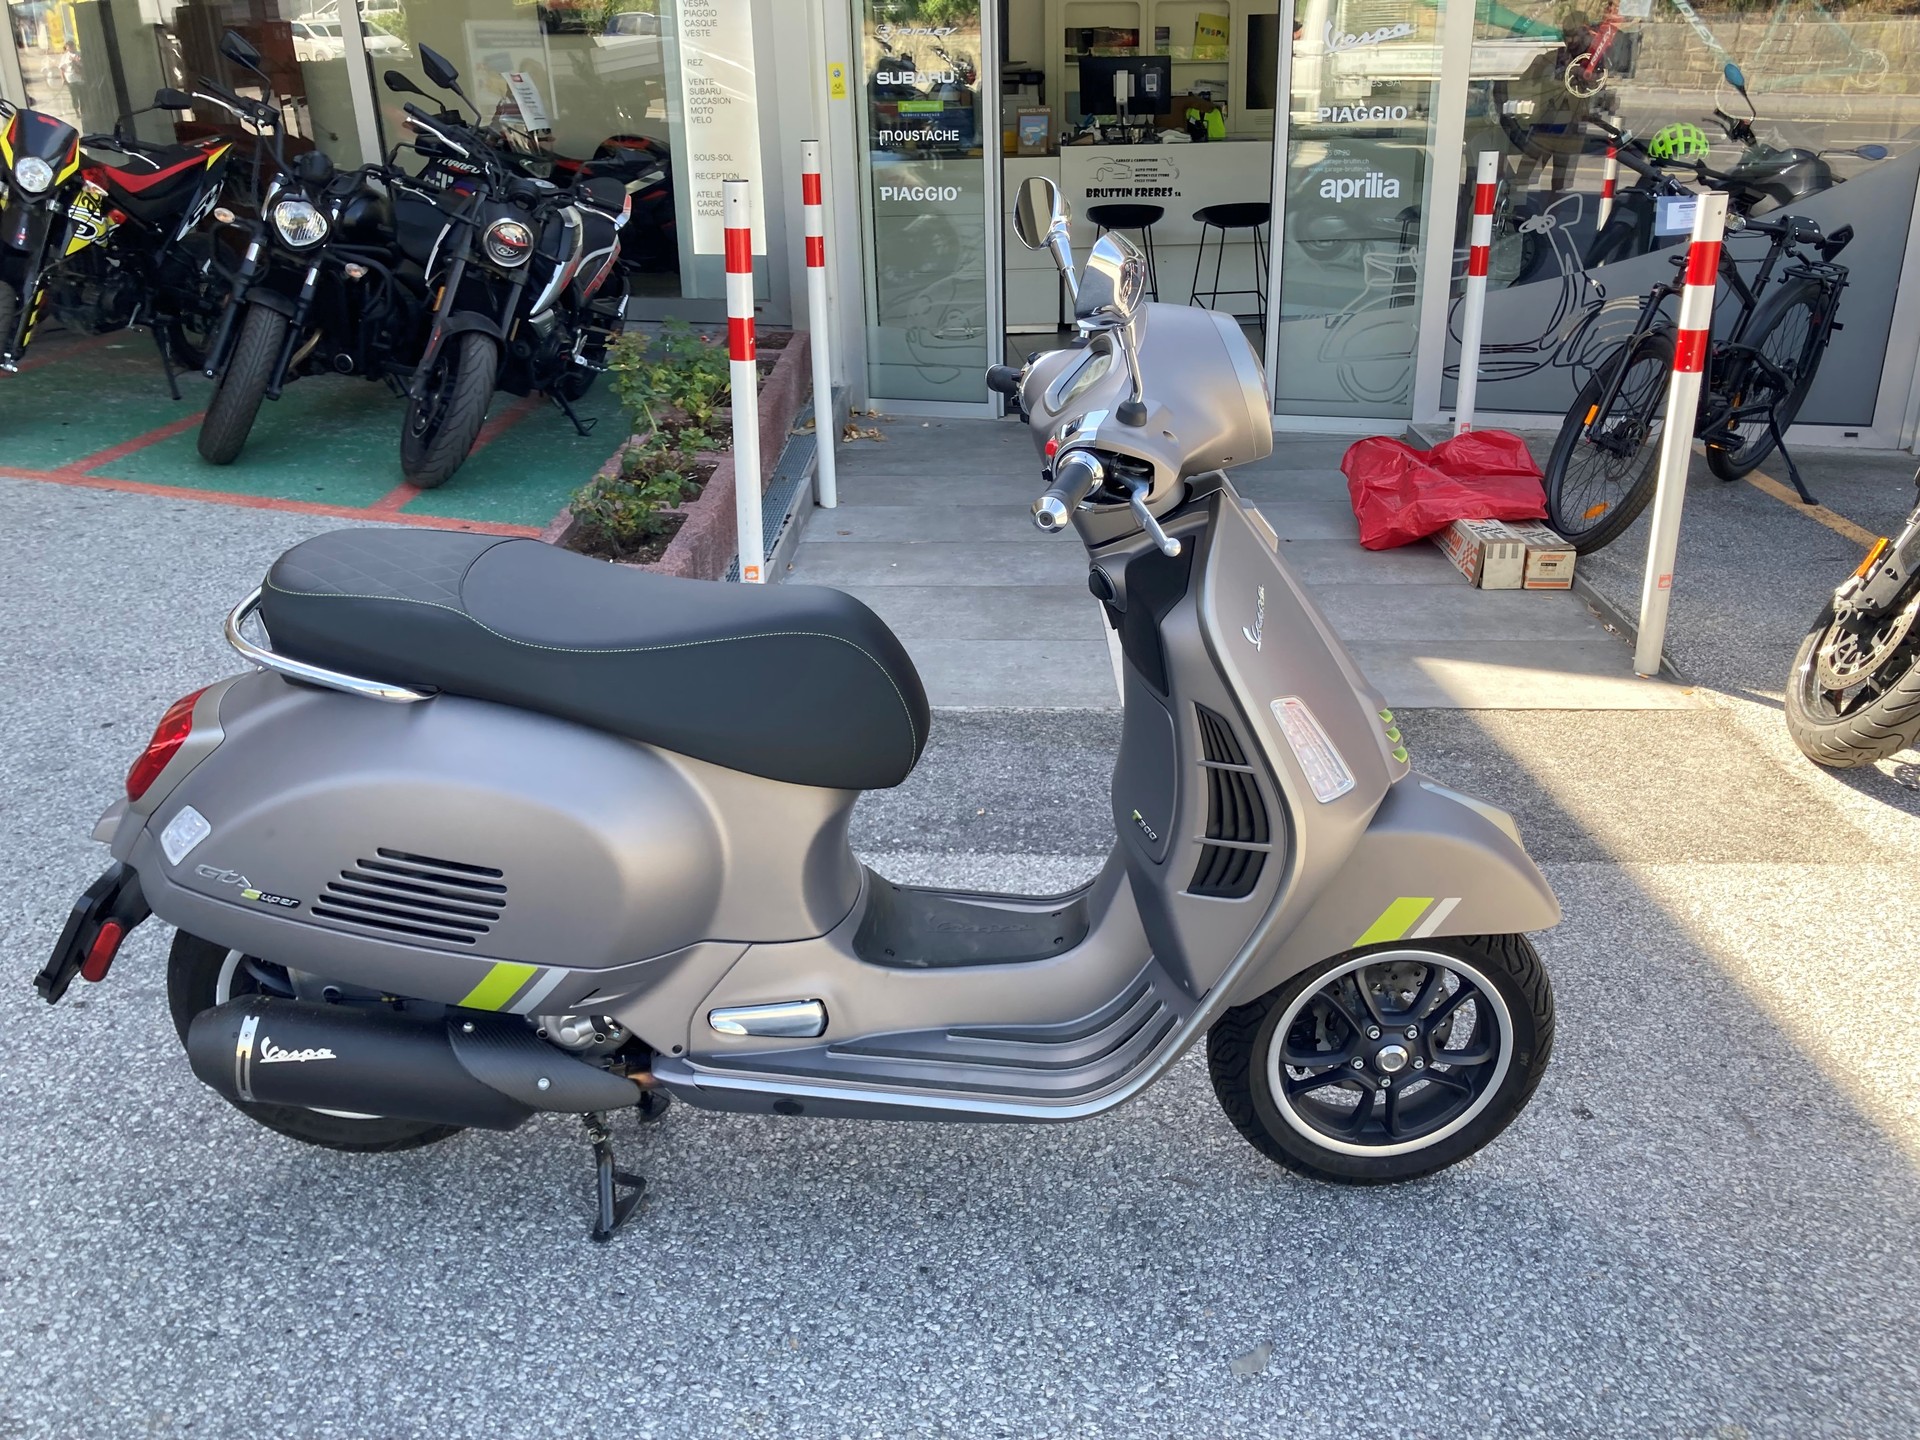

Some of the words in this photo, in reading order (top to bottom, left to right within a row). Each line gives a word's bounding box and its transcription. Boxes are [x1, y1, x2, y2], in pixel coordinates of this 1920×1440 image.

[684, 19, 718, 27] CASQUE
[685, 29, 711, 37] VESTE
[896, 27, 958, 37] RIDLEY
[1324, 20, 1418, 54] Vespa
[876, 71, 956, 85] SUBARU
[690, 97, 732, 105] OCCASION
[1318, 106, 1408, 122] PIAGGIO
[691, 116, 712, 124] VELO
[694, 153, 734, 161] SOUS-SOL
[695, 172, 740, 180] RECEPTION
[1319, 172, 1400, 203] aprilia
[697, 190, 723, 198] ATELIE
[880, 187, 958, 202] PIAGGIO
[1086, 188, 1133, 198] BRUTTIN
[1135, 187, 1173, 197] FRERES
[698, 209, 725, 217] MAGAS
[260, 1036, 337, 1063] Vespa
